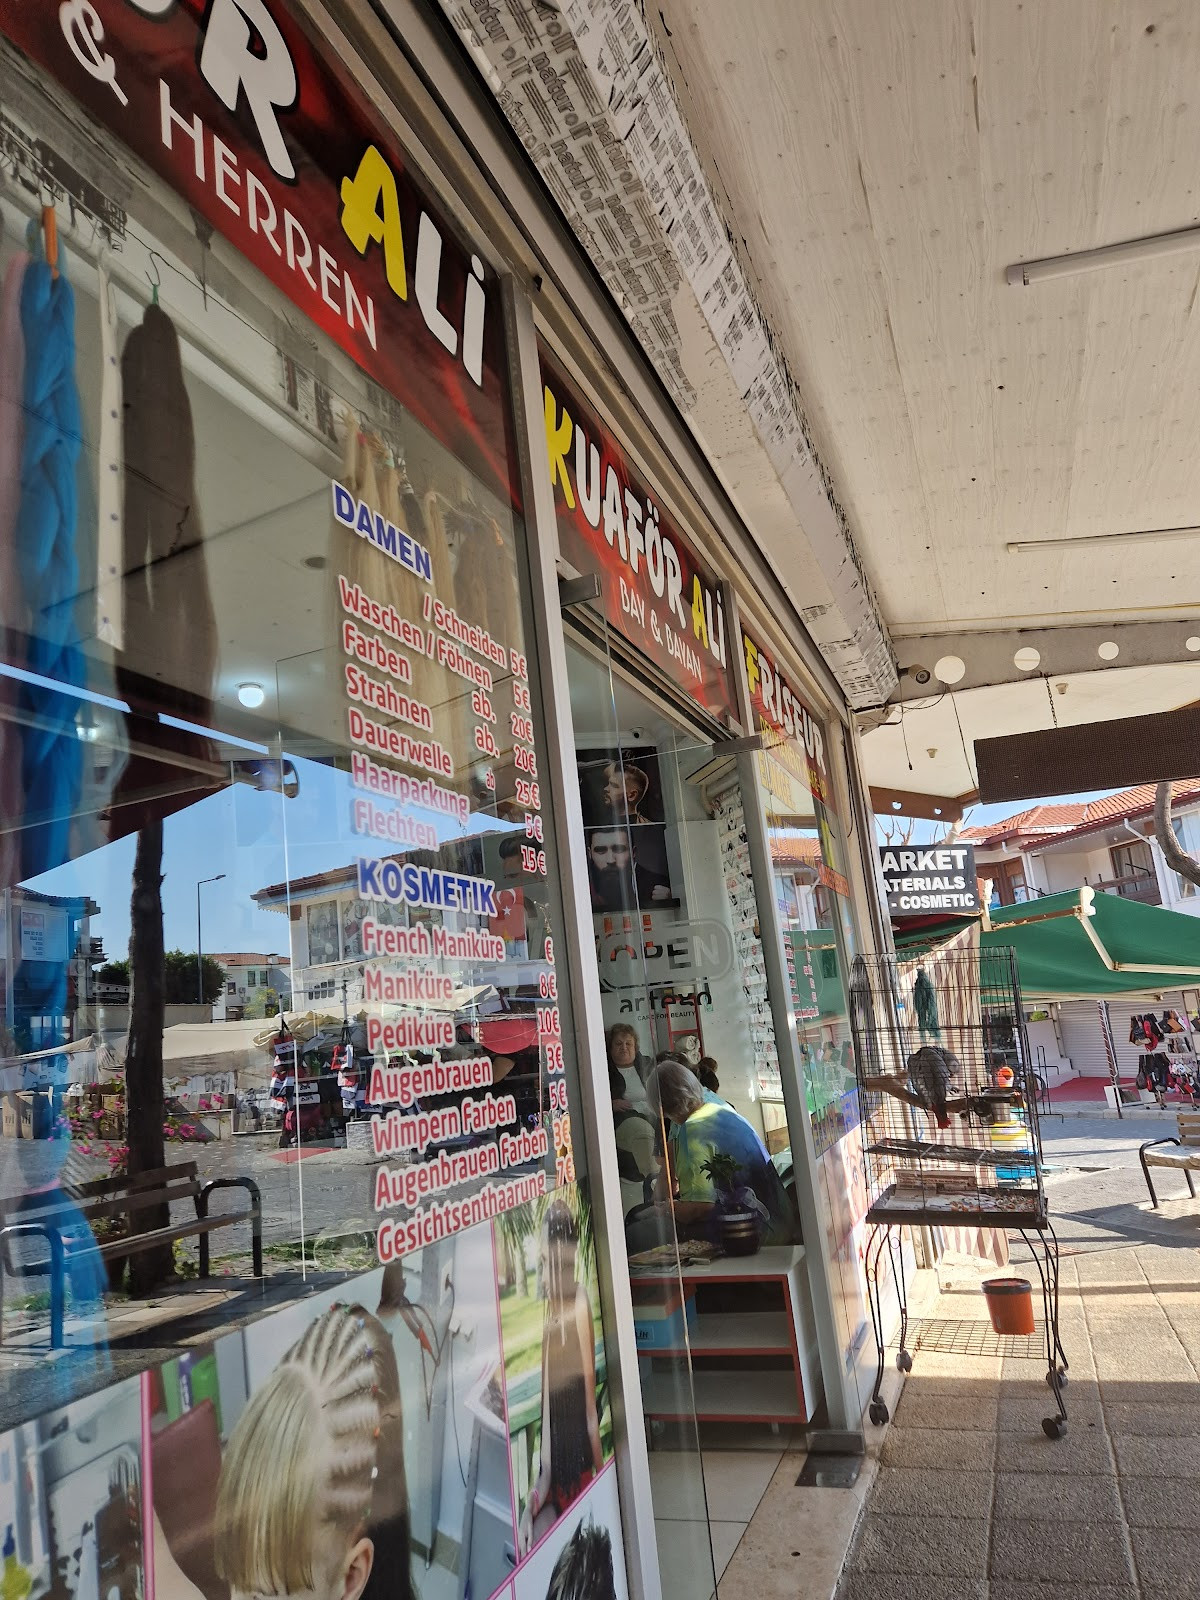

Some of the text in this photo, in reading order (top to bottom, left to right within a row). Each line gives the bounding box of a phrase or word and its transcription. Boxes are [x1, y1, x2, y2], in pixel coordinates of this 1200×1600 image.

[159, 78, 378, 351] HERREN
[335, 483, 431, 580] DAMEN
[544, 385, 686, 629] KUAFÖR
[340, 577, 423, 651] Waschen
[438, 645, 492, 690] Föhnen
[514, 682, 531, 711] 5€
[434, 604, 507, 668] Schneiden
[511, 649, 527, 680] 5€
[619, 577, 704, 683] BAY & BAYAN
[344, 626, 534, 744] Farben ab. 20€
[346, 667, 537, 776] Strahnen ab. 20€
[351, 710, 453, 775] Dauerwelle
[516, 780, 541, 810] 25€
[353, 755, 543, 842] Haarpackung 5€
[356, 801, 547, 874] Flechten 15€
[358, 857, 496, 915] KOSMETIK
[900, 893, 975, 910] COSMETIC
[363, 921, 430, 956] French
[433, 926, 504, 960] Maniküre
[366, 969, 557, 1001] Maniküre 8€
[670, 1010, 696, 1019] BEAUTY
[367, 1009, 560, 1050] Pediküre 10€
[371, 1046, 563, 1104] Augenbrauen 3€
[373, 1084, 566, 1152] Wimpern Farben 5€
[376, 1121, 571, 1209] Augenbrauen Farben 3€
[379, 1173, 546, 1262] Gesichtsenthaarung
